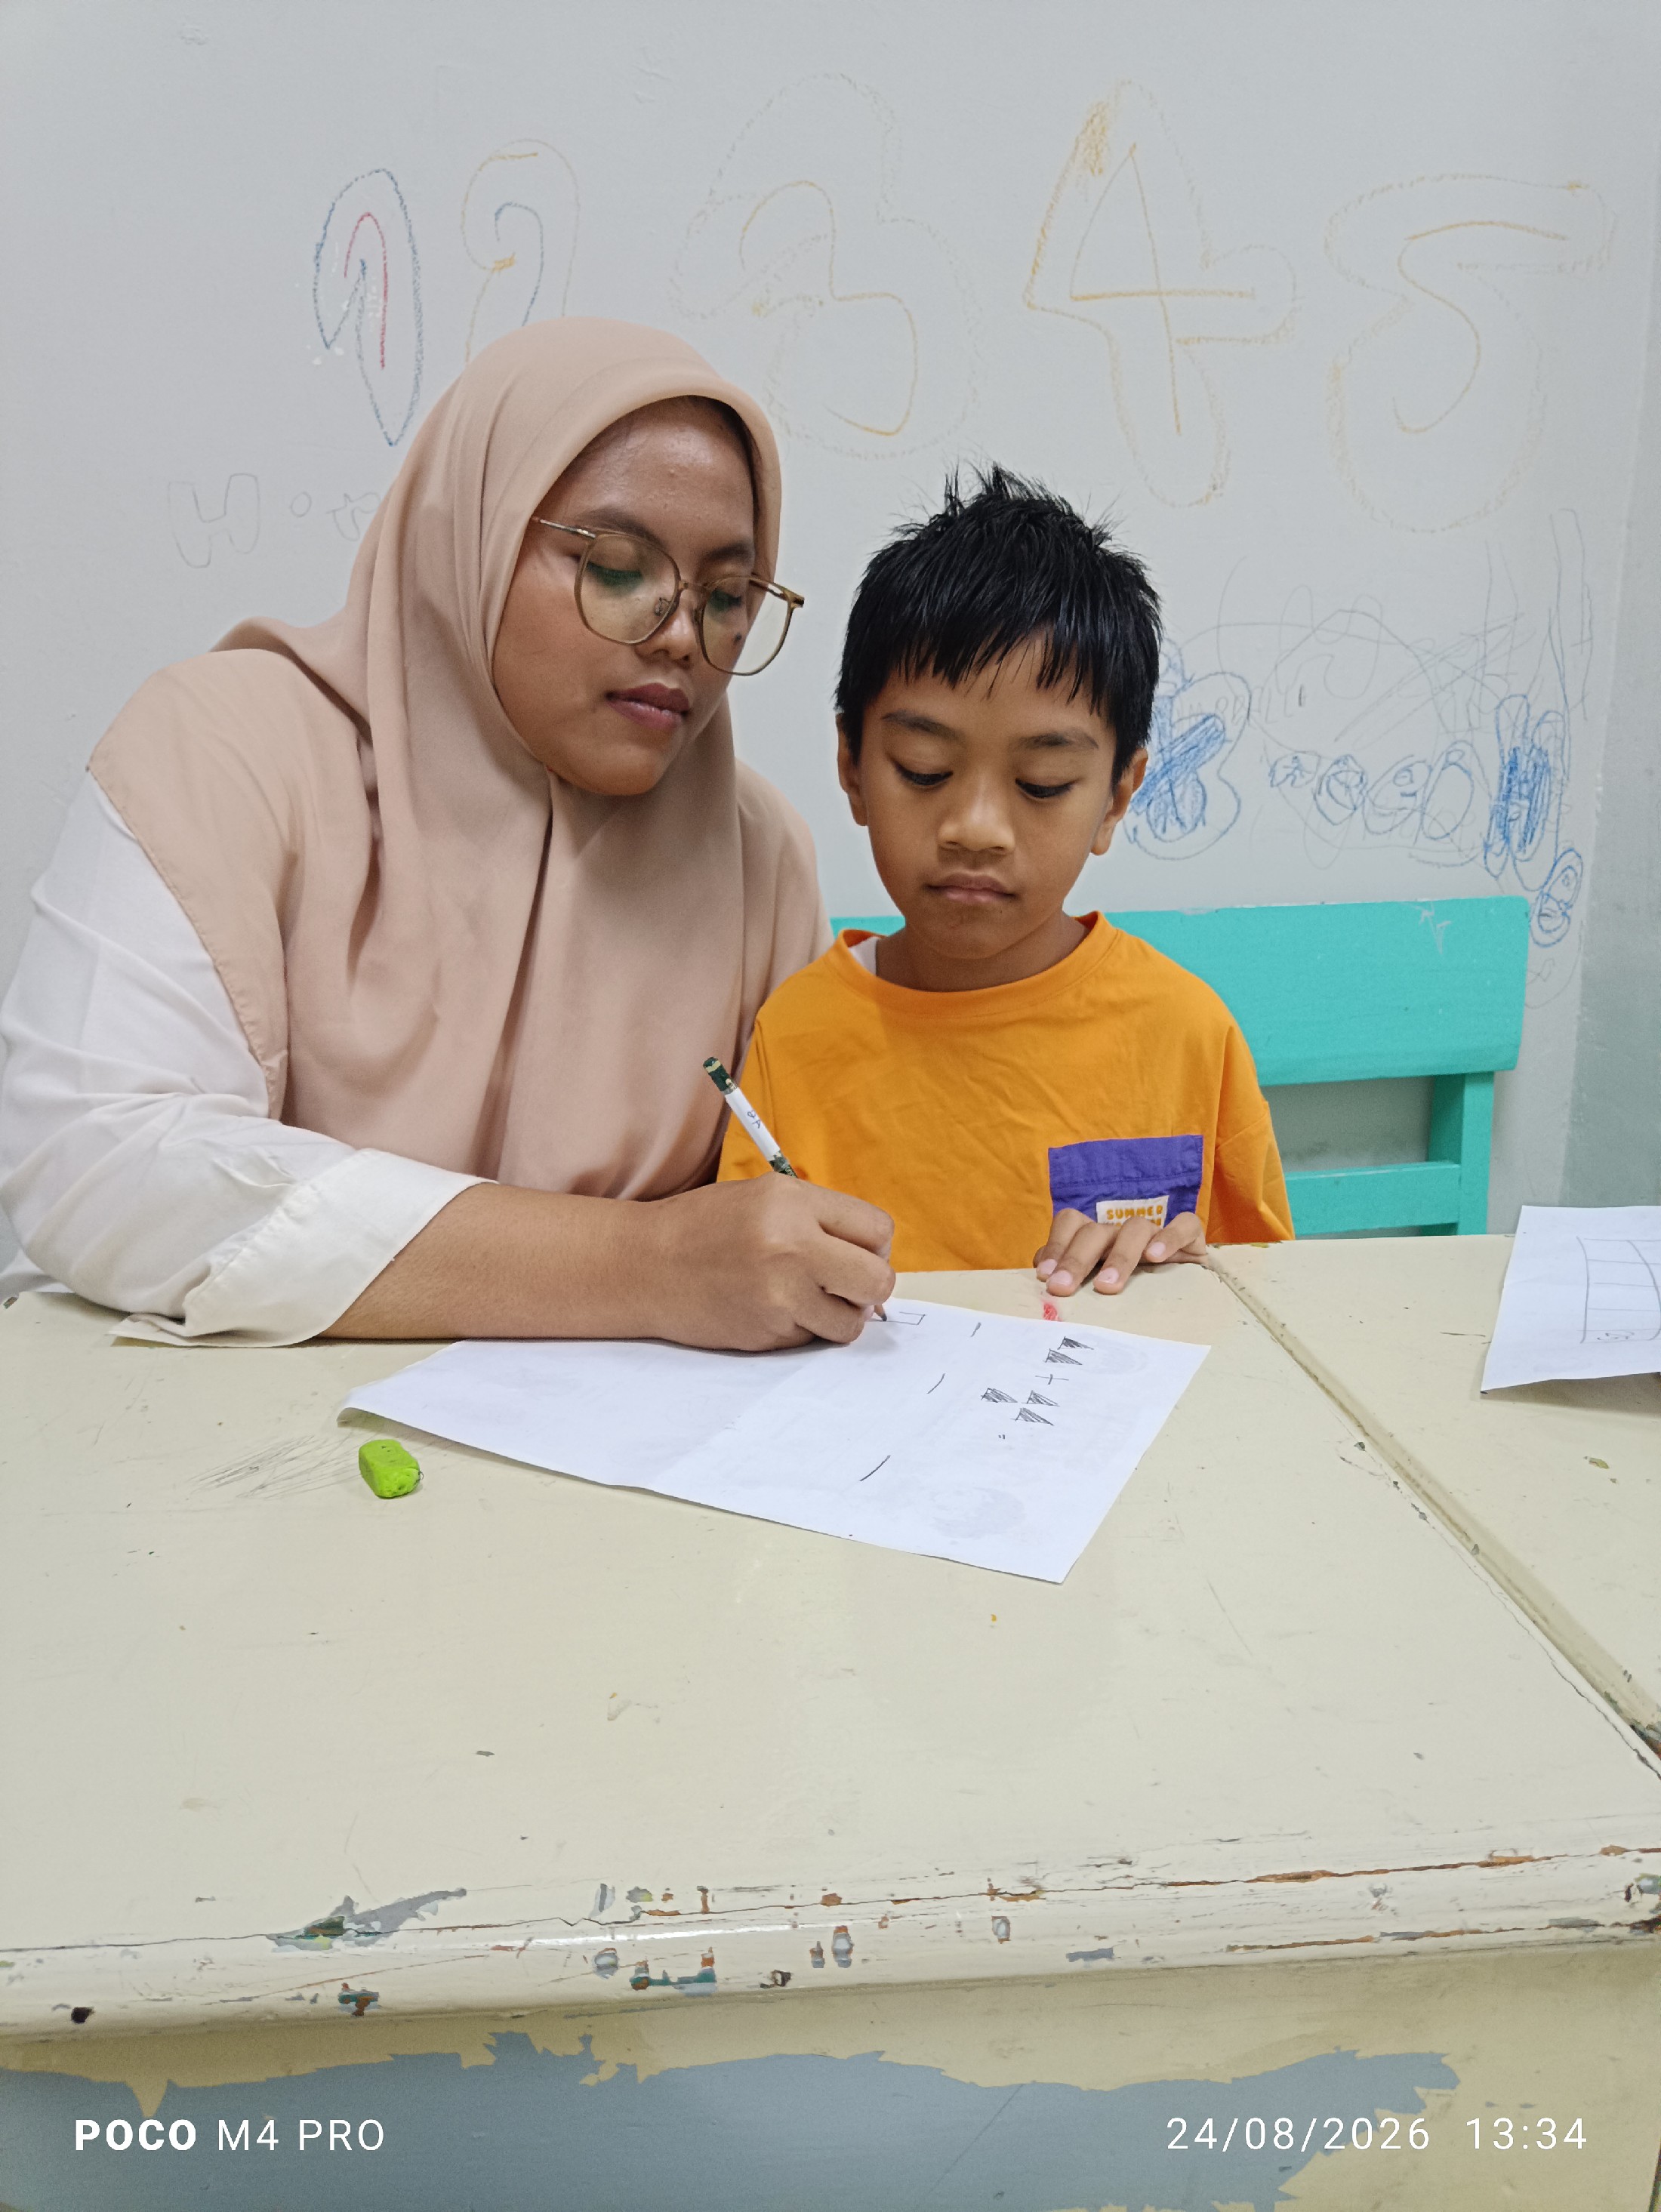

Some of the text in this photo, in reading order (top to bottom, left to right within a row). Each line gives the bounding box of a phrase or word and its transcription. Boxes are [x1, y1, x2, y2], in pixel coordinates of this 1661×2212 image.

[668, 73, 985, 457] 3
[1023, 79, 1297, 507] 4
[1324, 173, 1618, 533] 5
